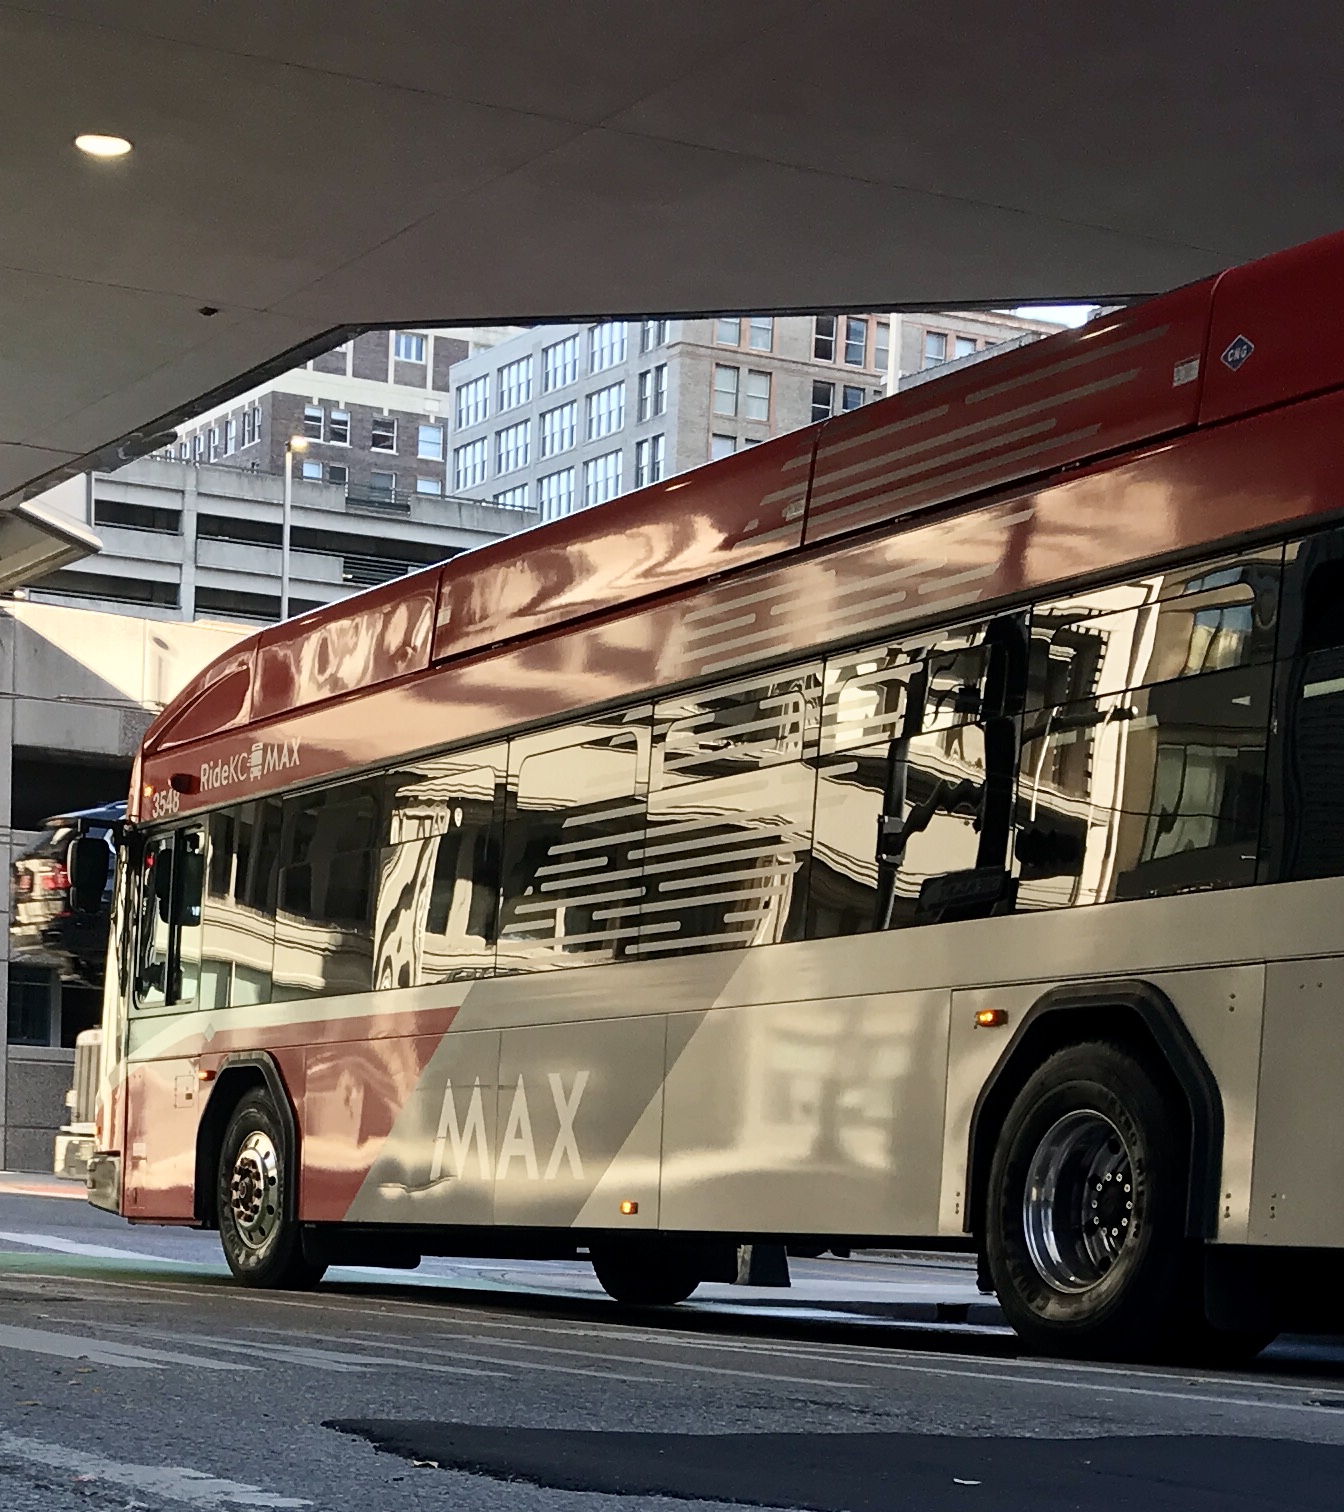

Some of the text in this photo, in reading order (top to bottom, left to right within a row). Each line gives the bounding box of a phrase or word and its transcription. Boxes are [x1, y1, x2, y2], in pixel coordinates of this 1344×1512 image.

[1227, 344, 1248, 362] CNG
[199, 736, 302, 792] RideKC MAX
[152, 789, 180, 818] 3548
[429, 1070, 591, 1181] MAX
